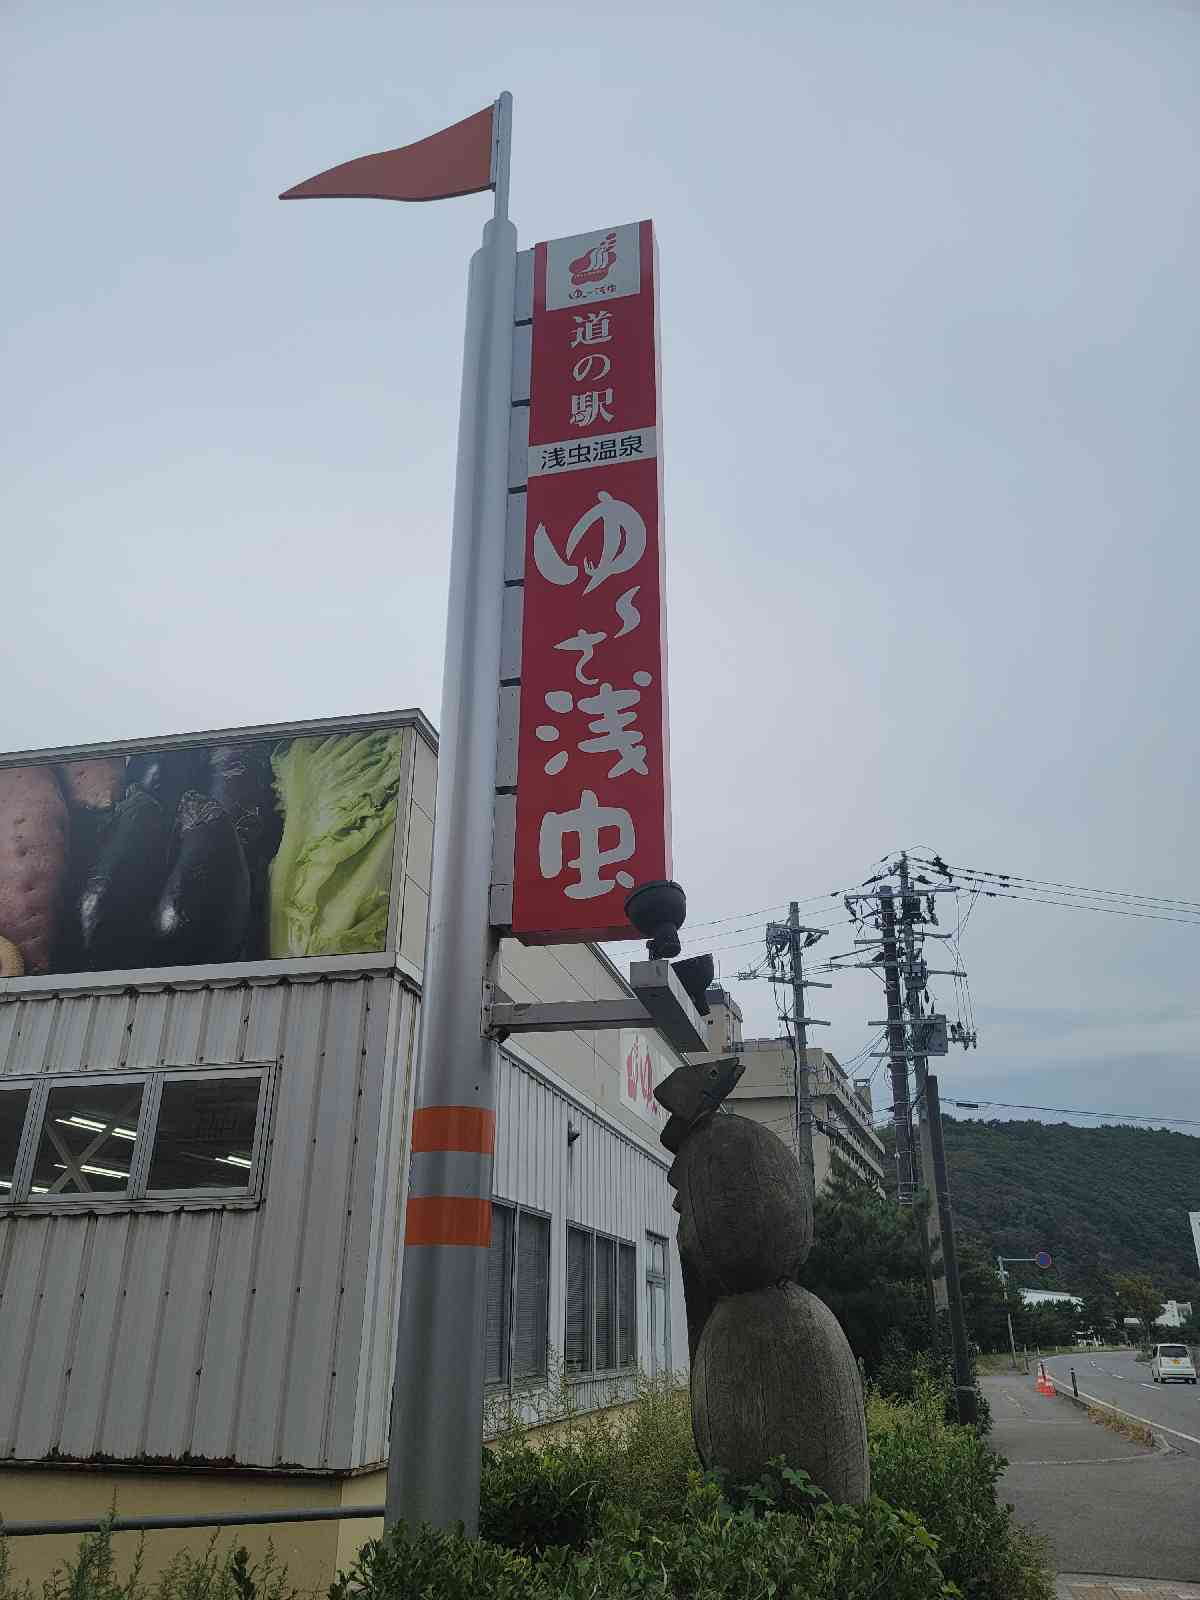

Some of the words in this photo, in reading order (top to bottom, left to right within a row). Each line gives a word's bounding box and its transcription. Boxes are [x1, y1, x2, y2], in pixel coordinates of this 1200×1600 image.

[569, 310, 615, 427] 道の駅
[541, 435, 643, 469] 浅虫温泉
